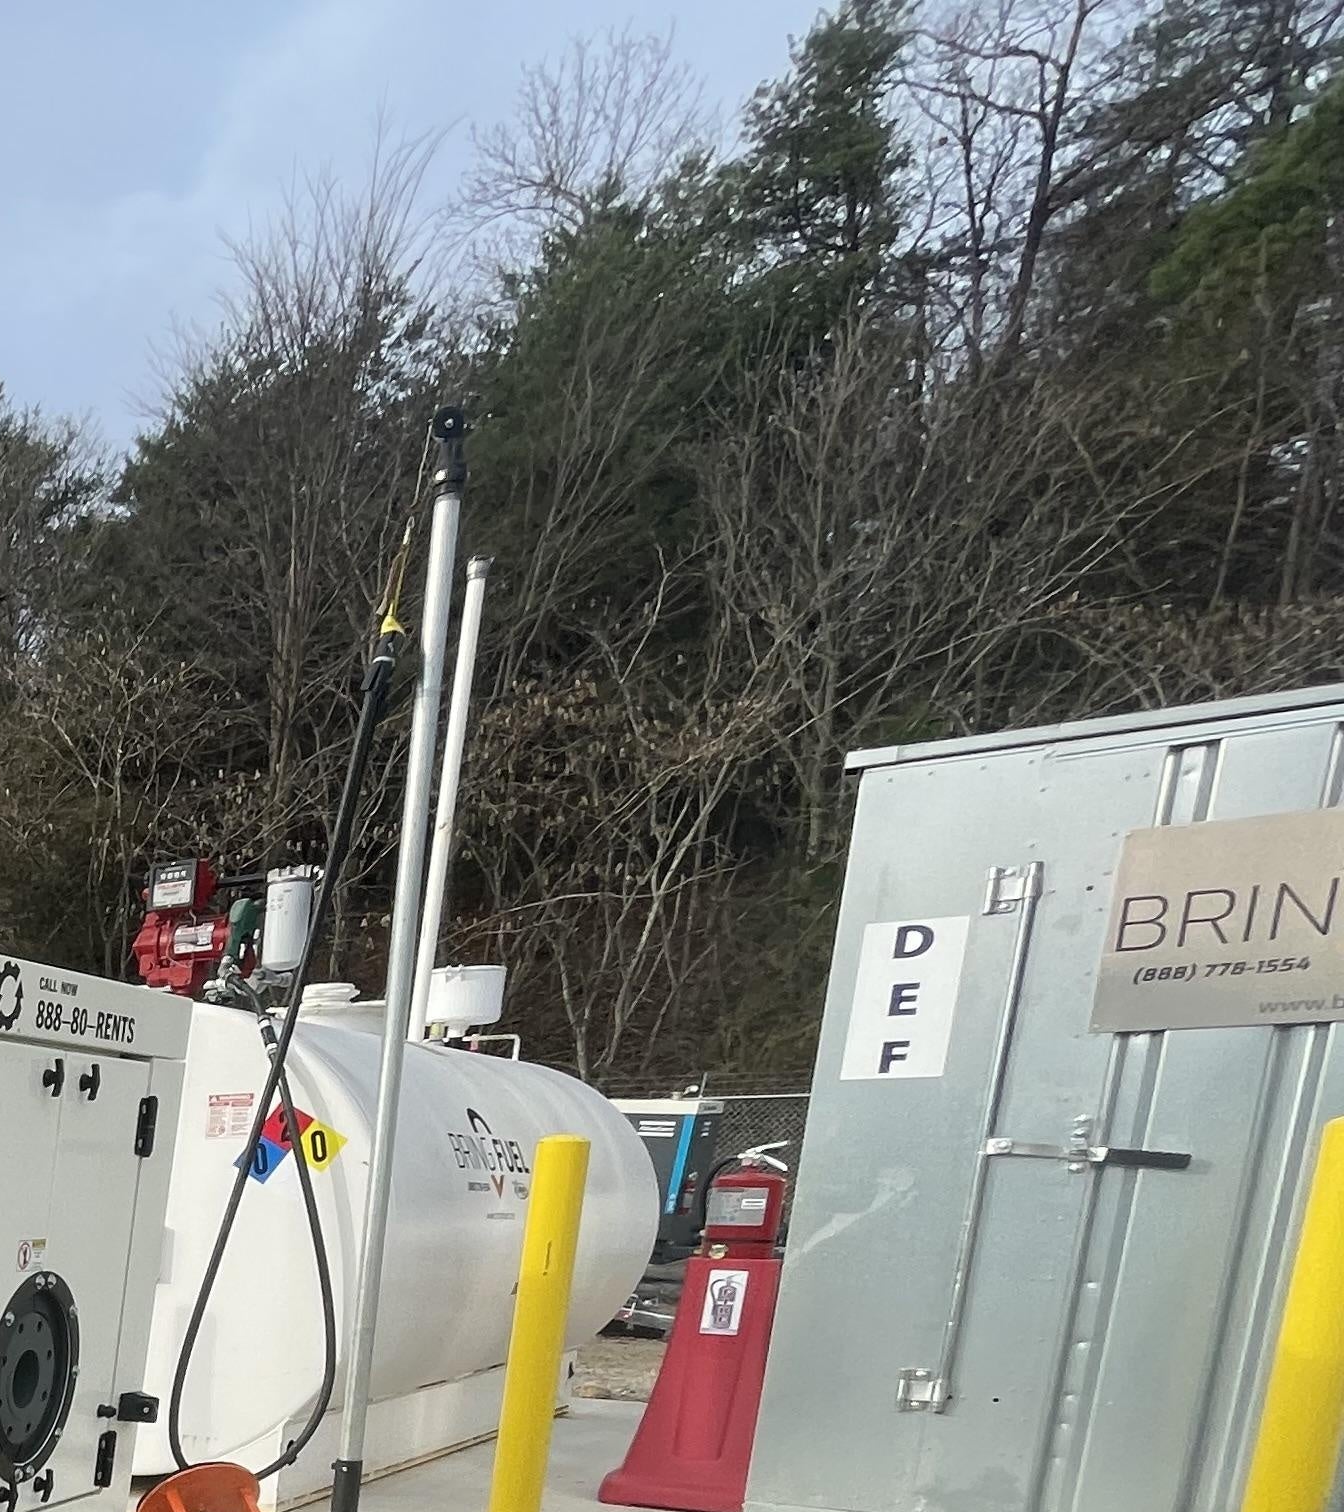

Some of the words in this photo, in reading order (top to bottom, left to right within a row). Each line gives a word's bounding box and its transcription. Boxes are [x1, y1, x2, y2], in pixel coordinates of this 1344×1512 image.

[1115, 877, 1340, 952] BRIN
[39, 977, 58, 993] CALL
[61, 981, 79, 997] NOW
[1133, 963, 1197, 985] (888)
[1204, 956, 1311, 977] 778-1554
[36, 1000, 136, 1044] 888-80-RENTS
[310, 1130, 328, 1163] 0
[492, 1139, 530, 1174] FUEL
